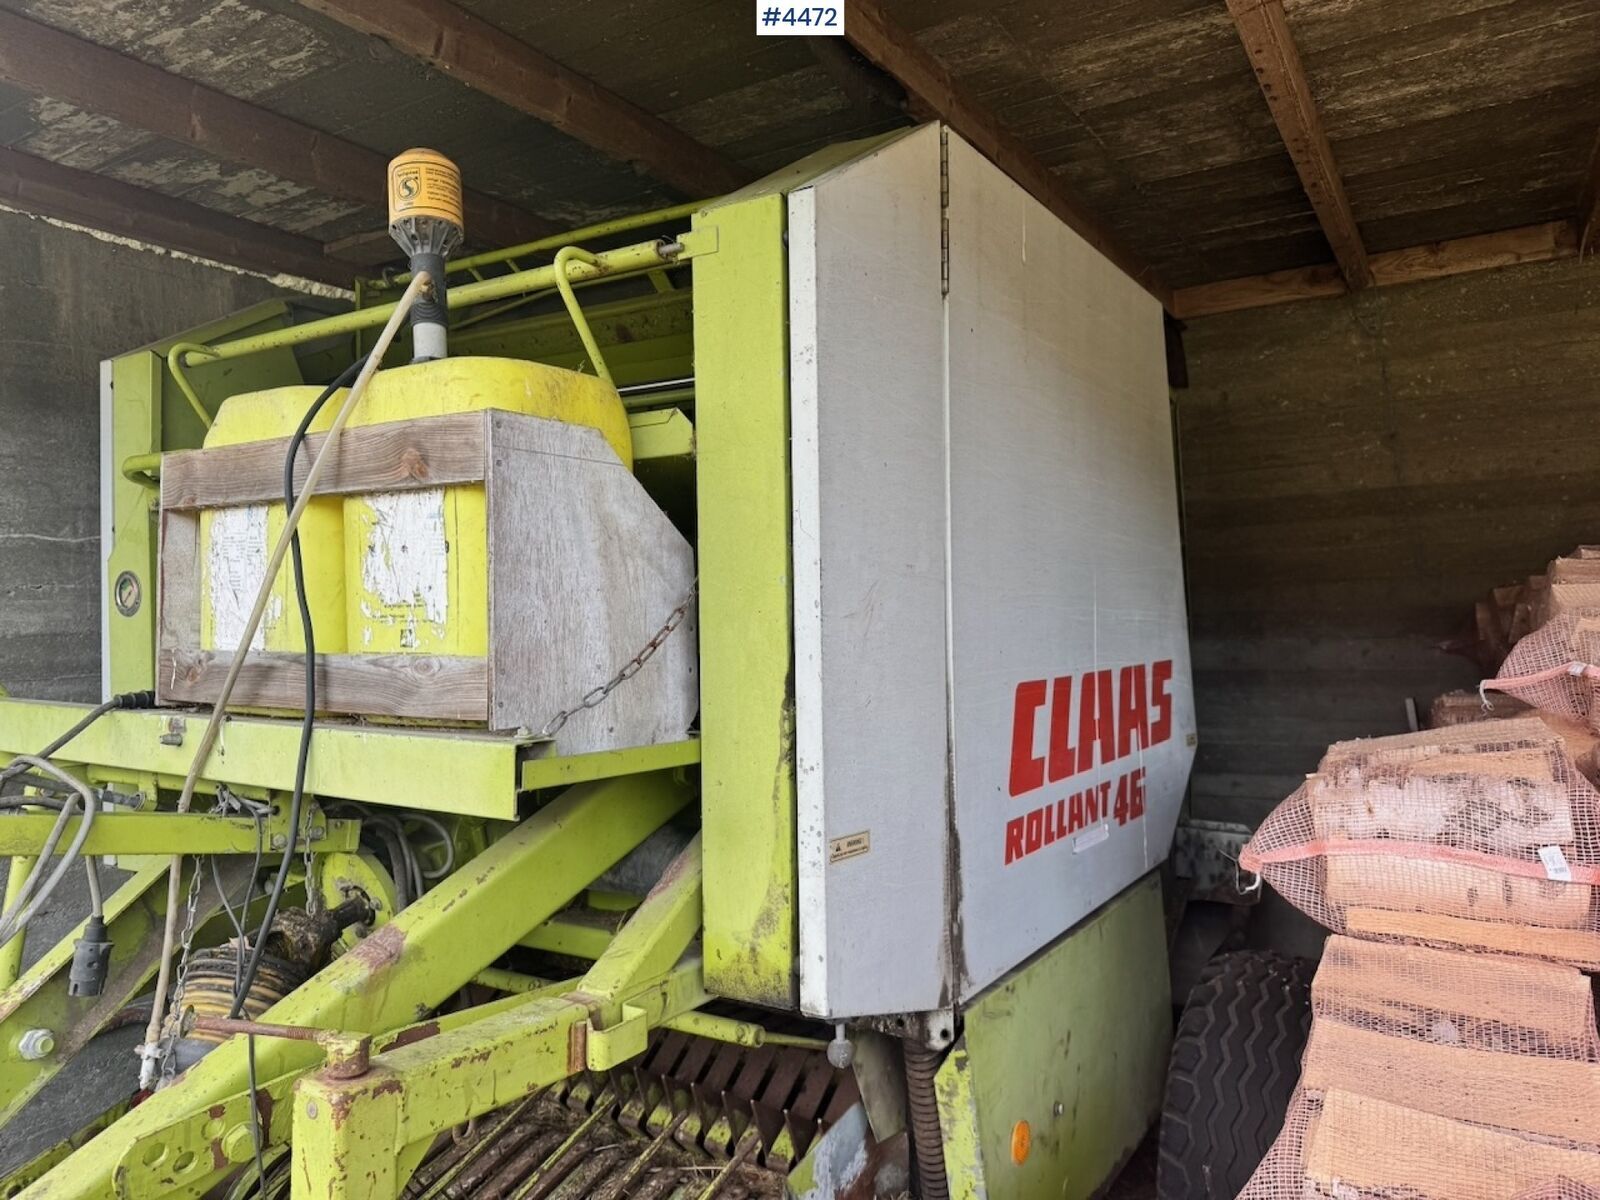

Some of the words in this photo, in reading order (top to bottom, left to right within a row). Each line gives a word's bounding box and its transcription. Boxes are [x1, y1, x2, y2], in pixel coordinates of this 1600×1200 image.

[1009, 659, 1172, 797] CLAAS
[1005, 780, 1111, 866] ROLLANT
[1113, 766, 1146, 827] 46
